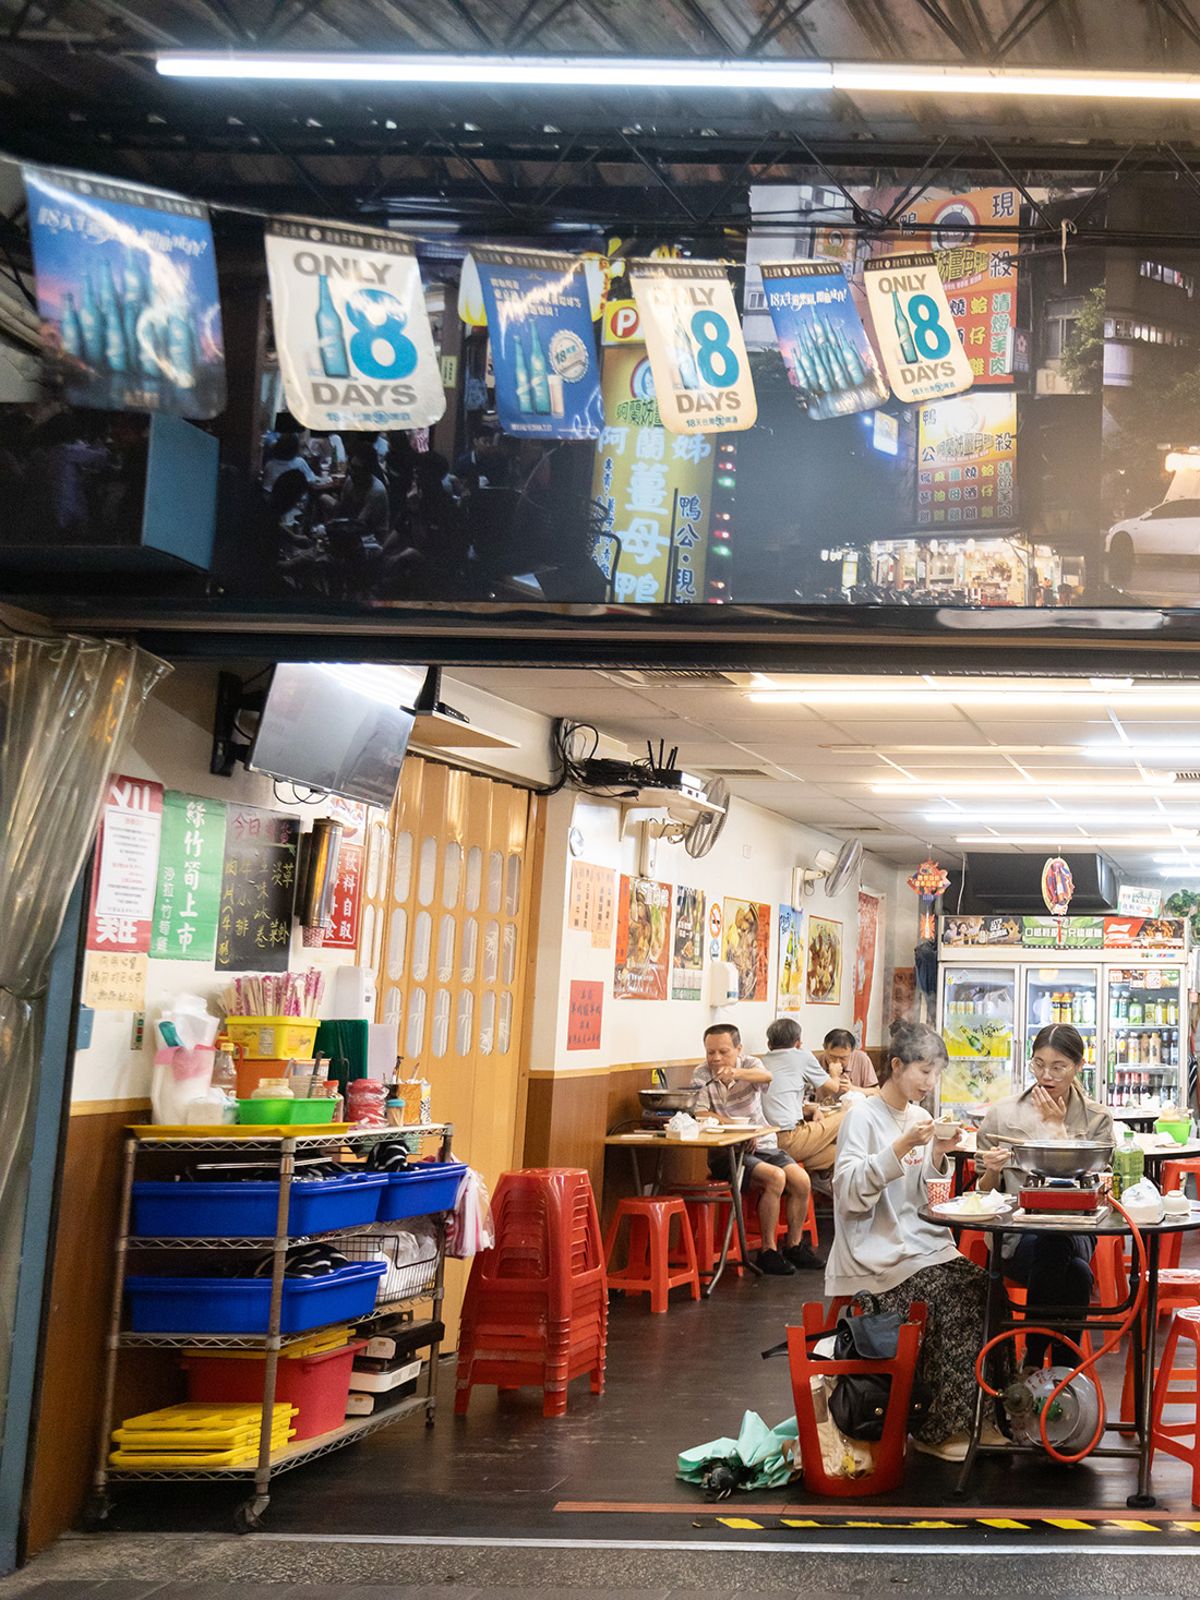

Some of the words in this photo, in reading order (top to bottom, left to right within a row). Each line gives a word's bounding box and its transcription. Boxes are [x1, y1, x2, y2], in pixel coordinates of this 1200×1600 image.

[294, 252, 392, 285] ONLY
[878, 274, 928, 295] ONLY
[900, 361, 956, 386] DAYS
[312, 382, 418, 406] DAYS
[676, 391, 741, 414] DAYS
[176, 802, 206, 954] 綠竹筍上市
